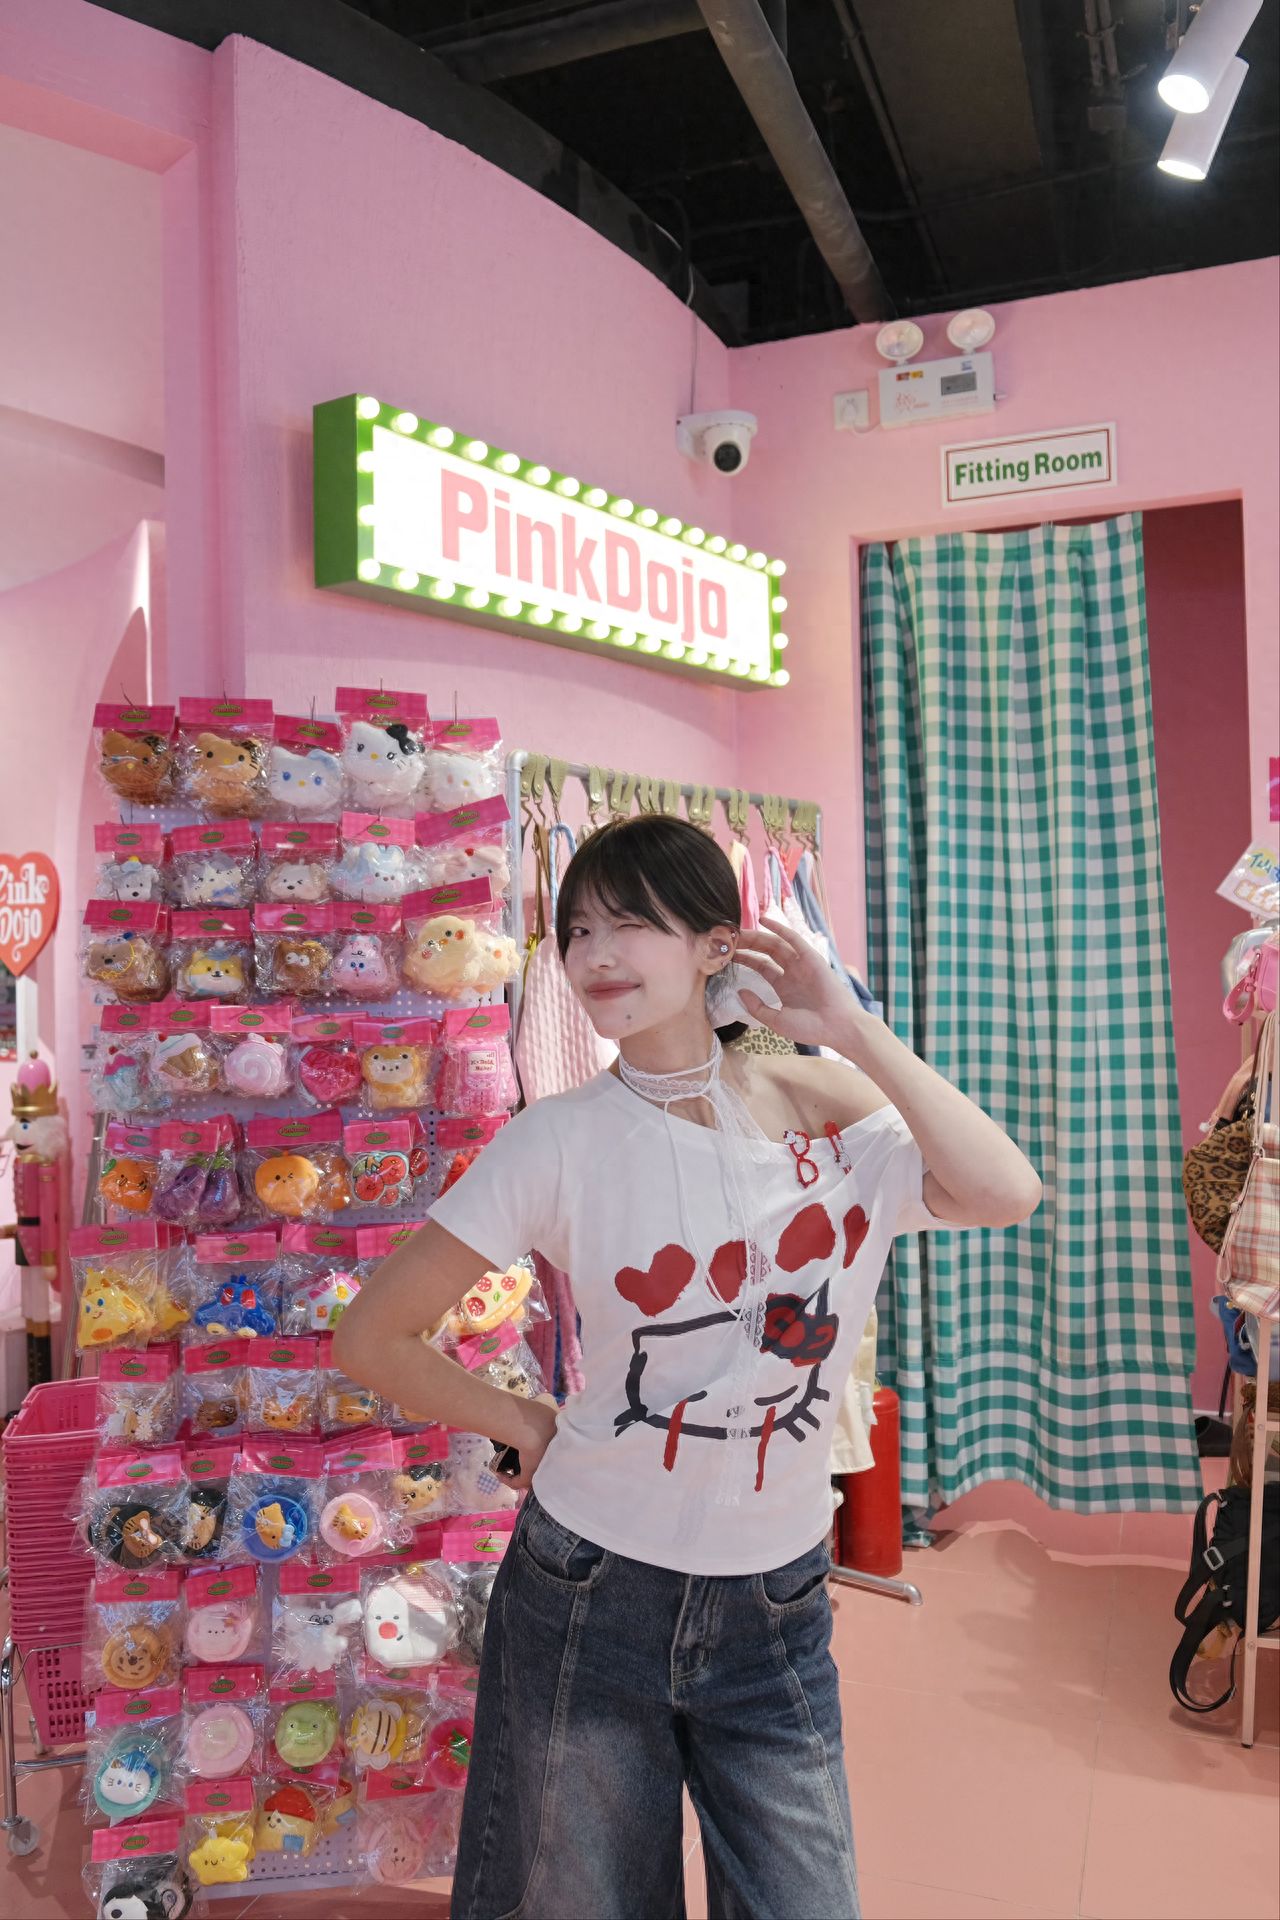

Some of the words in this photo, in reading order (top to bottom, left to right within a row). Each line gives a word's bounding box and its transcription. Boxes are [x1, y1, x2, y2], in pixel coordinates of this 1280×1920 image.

[955, 458, 1030, 482] Fitting
[1034, 450, 1102, 475] Room
[440, 468, 728, 644] PinkDojo
